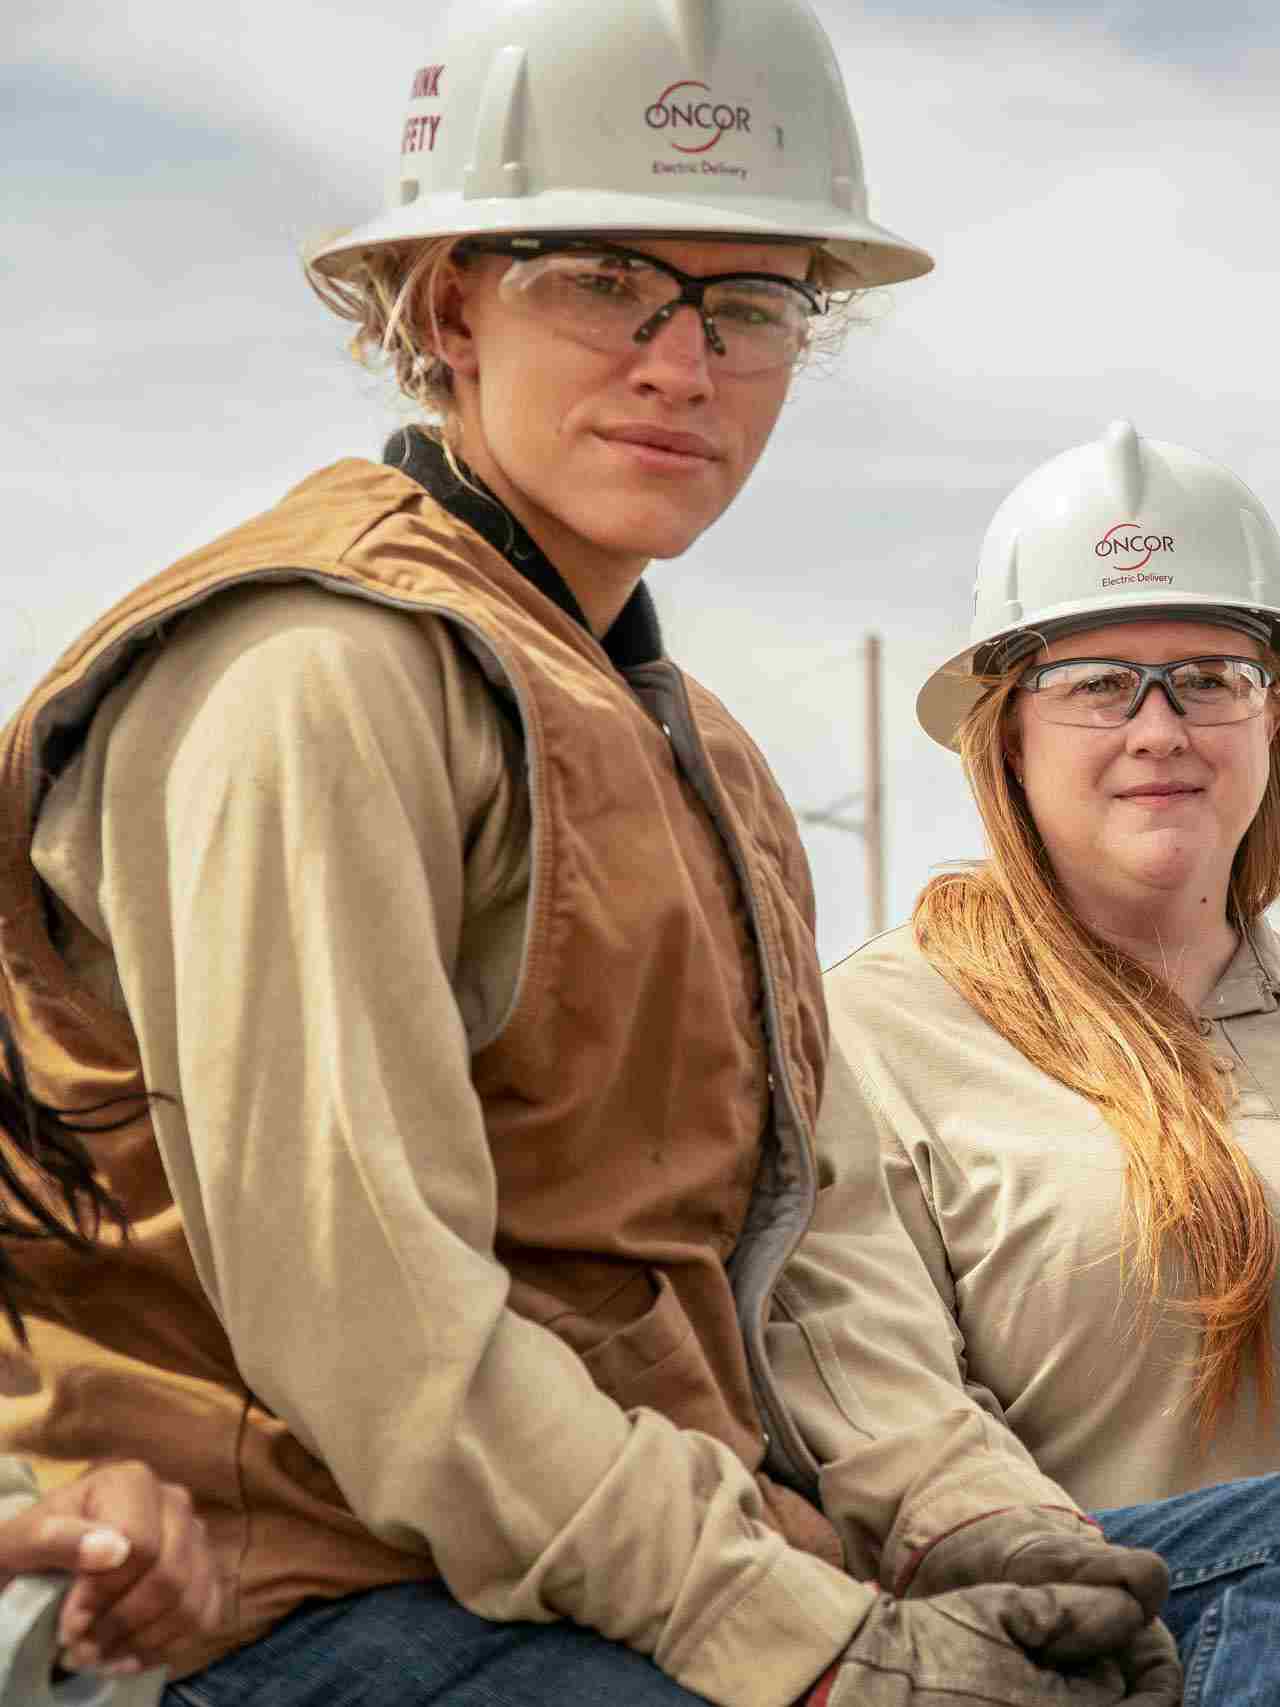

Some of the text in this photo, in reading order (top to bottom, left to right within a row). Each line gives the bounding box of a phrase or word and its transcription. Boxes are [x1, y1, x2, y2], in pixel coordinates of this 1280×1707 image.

[645, 103, 751, 133] ONCOR
[1095, 535, 1175, 557] ONCOR
[1102, 572, 1174, 587] Electric Delivery
